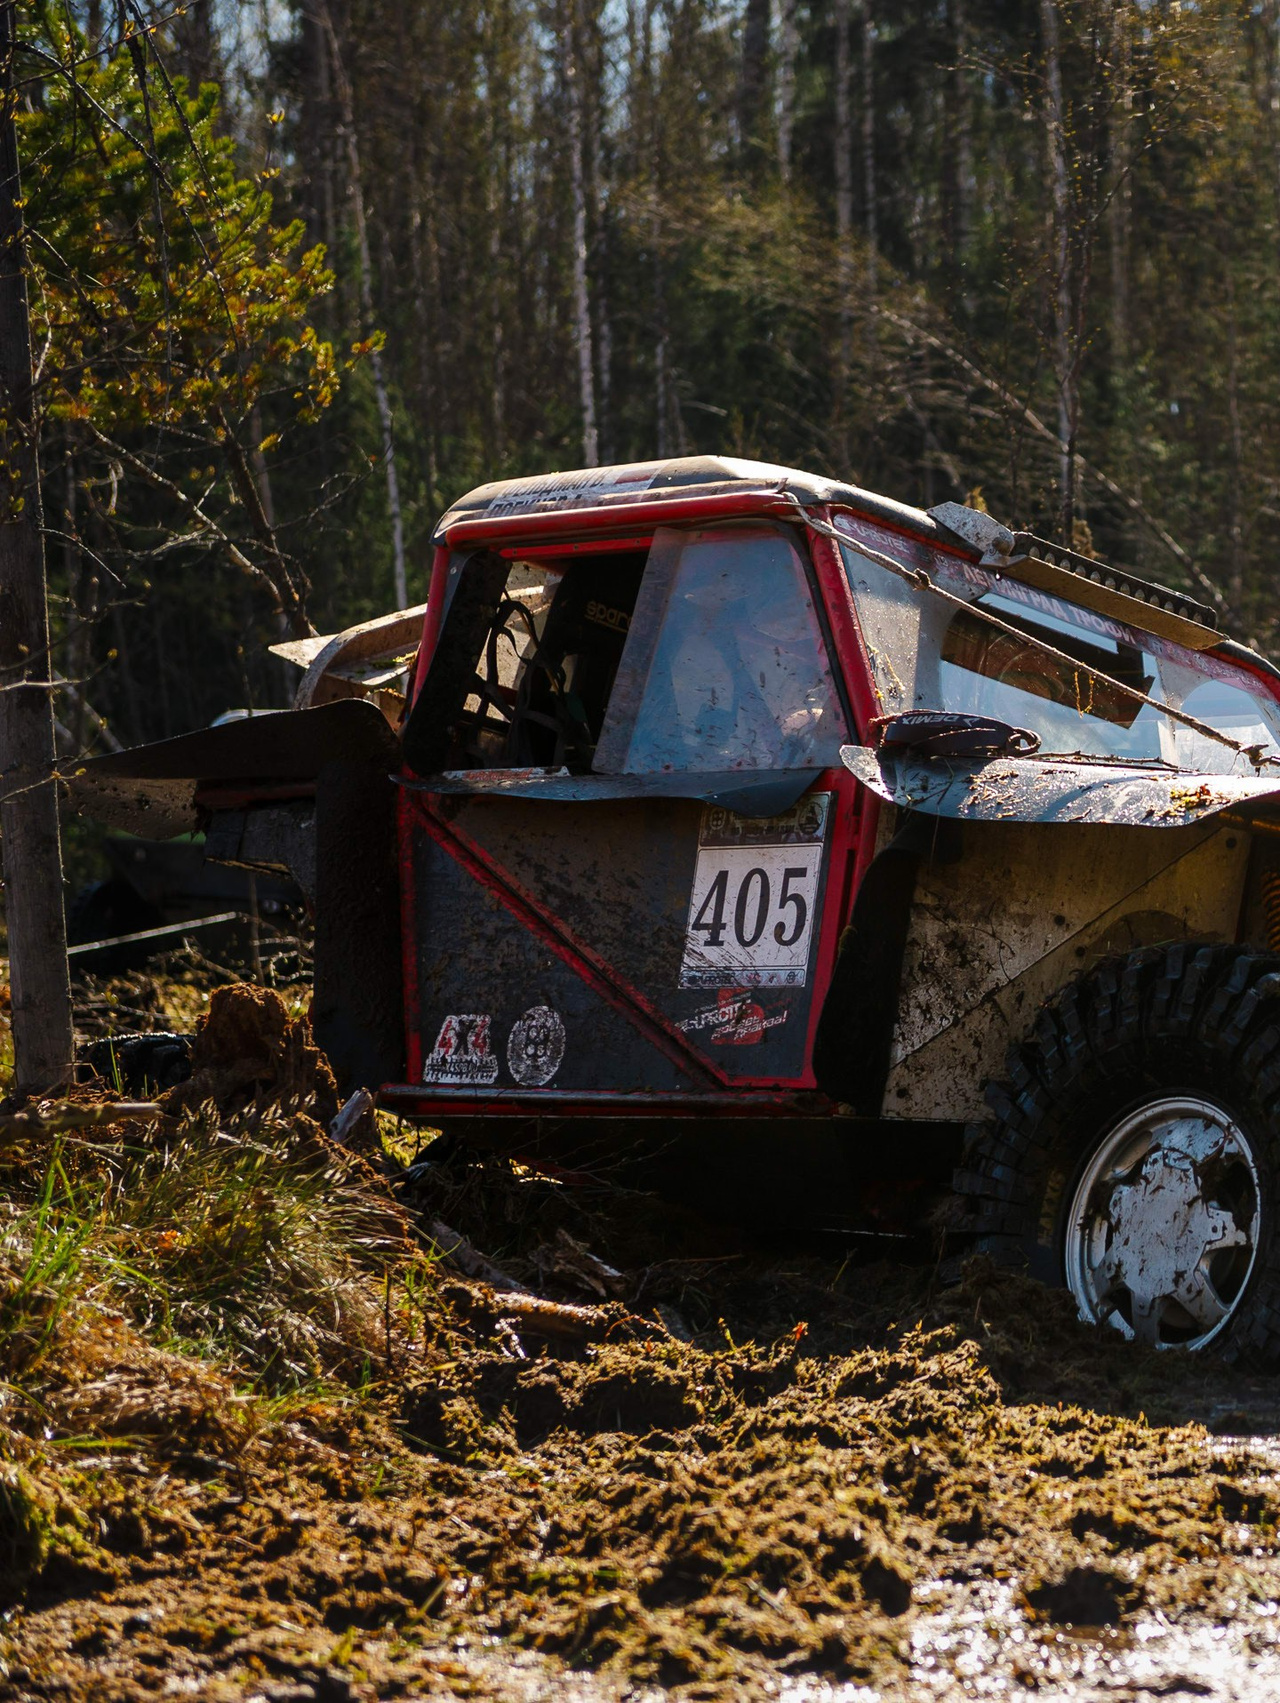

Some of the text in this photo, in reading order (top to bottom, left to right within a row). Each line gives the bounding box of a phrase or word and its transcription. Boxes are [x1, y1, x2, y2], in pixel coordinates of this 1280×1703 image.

[585, 600, 631, 629] spar
[1069, 604, 1136, 645] ТРОФИ
[902, 712, 960, 725] DEMIX
[692, 867, 807, 947] 405
